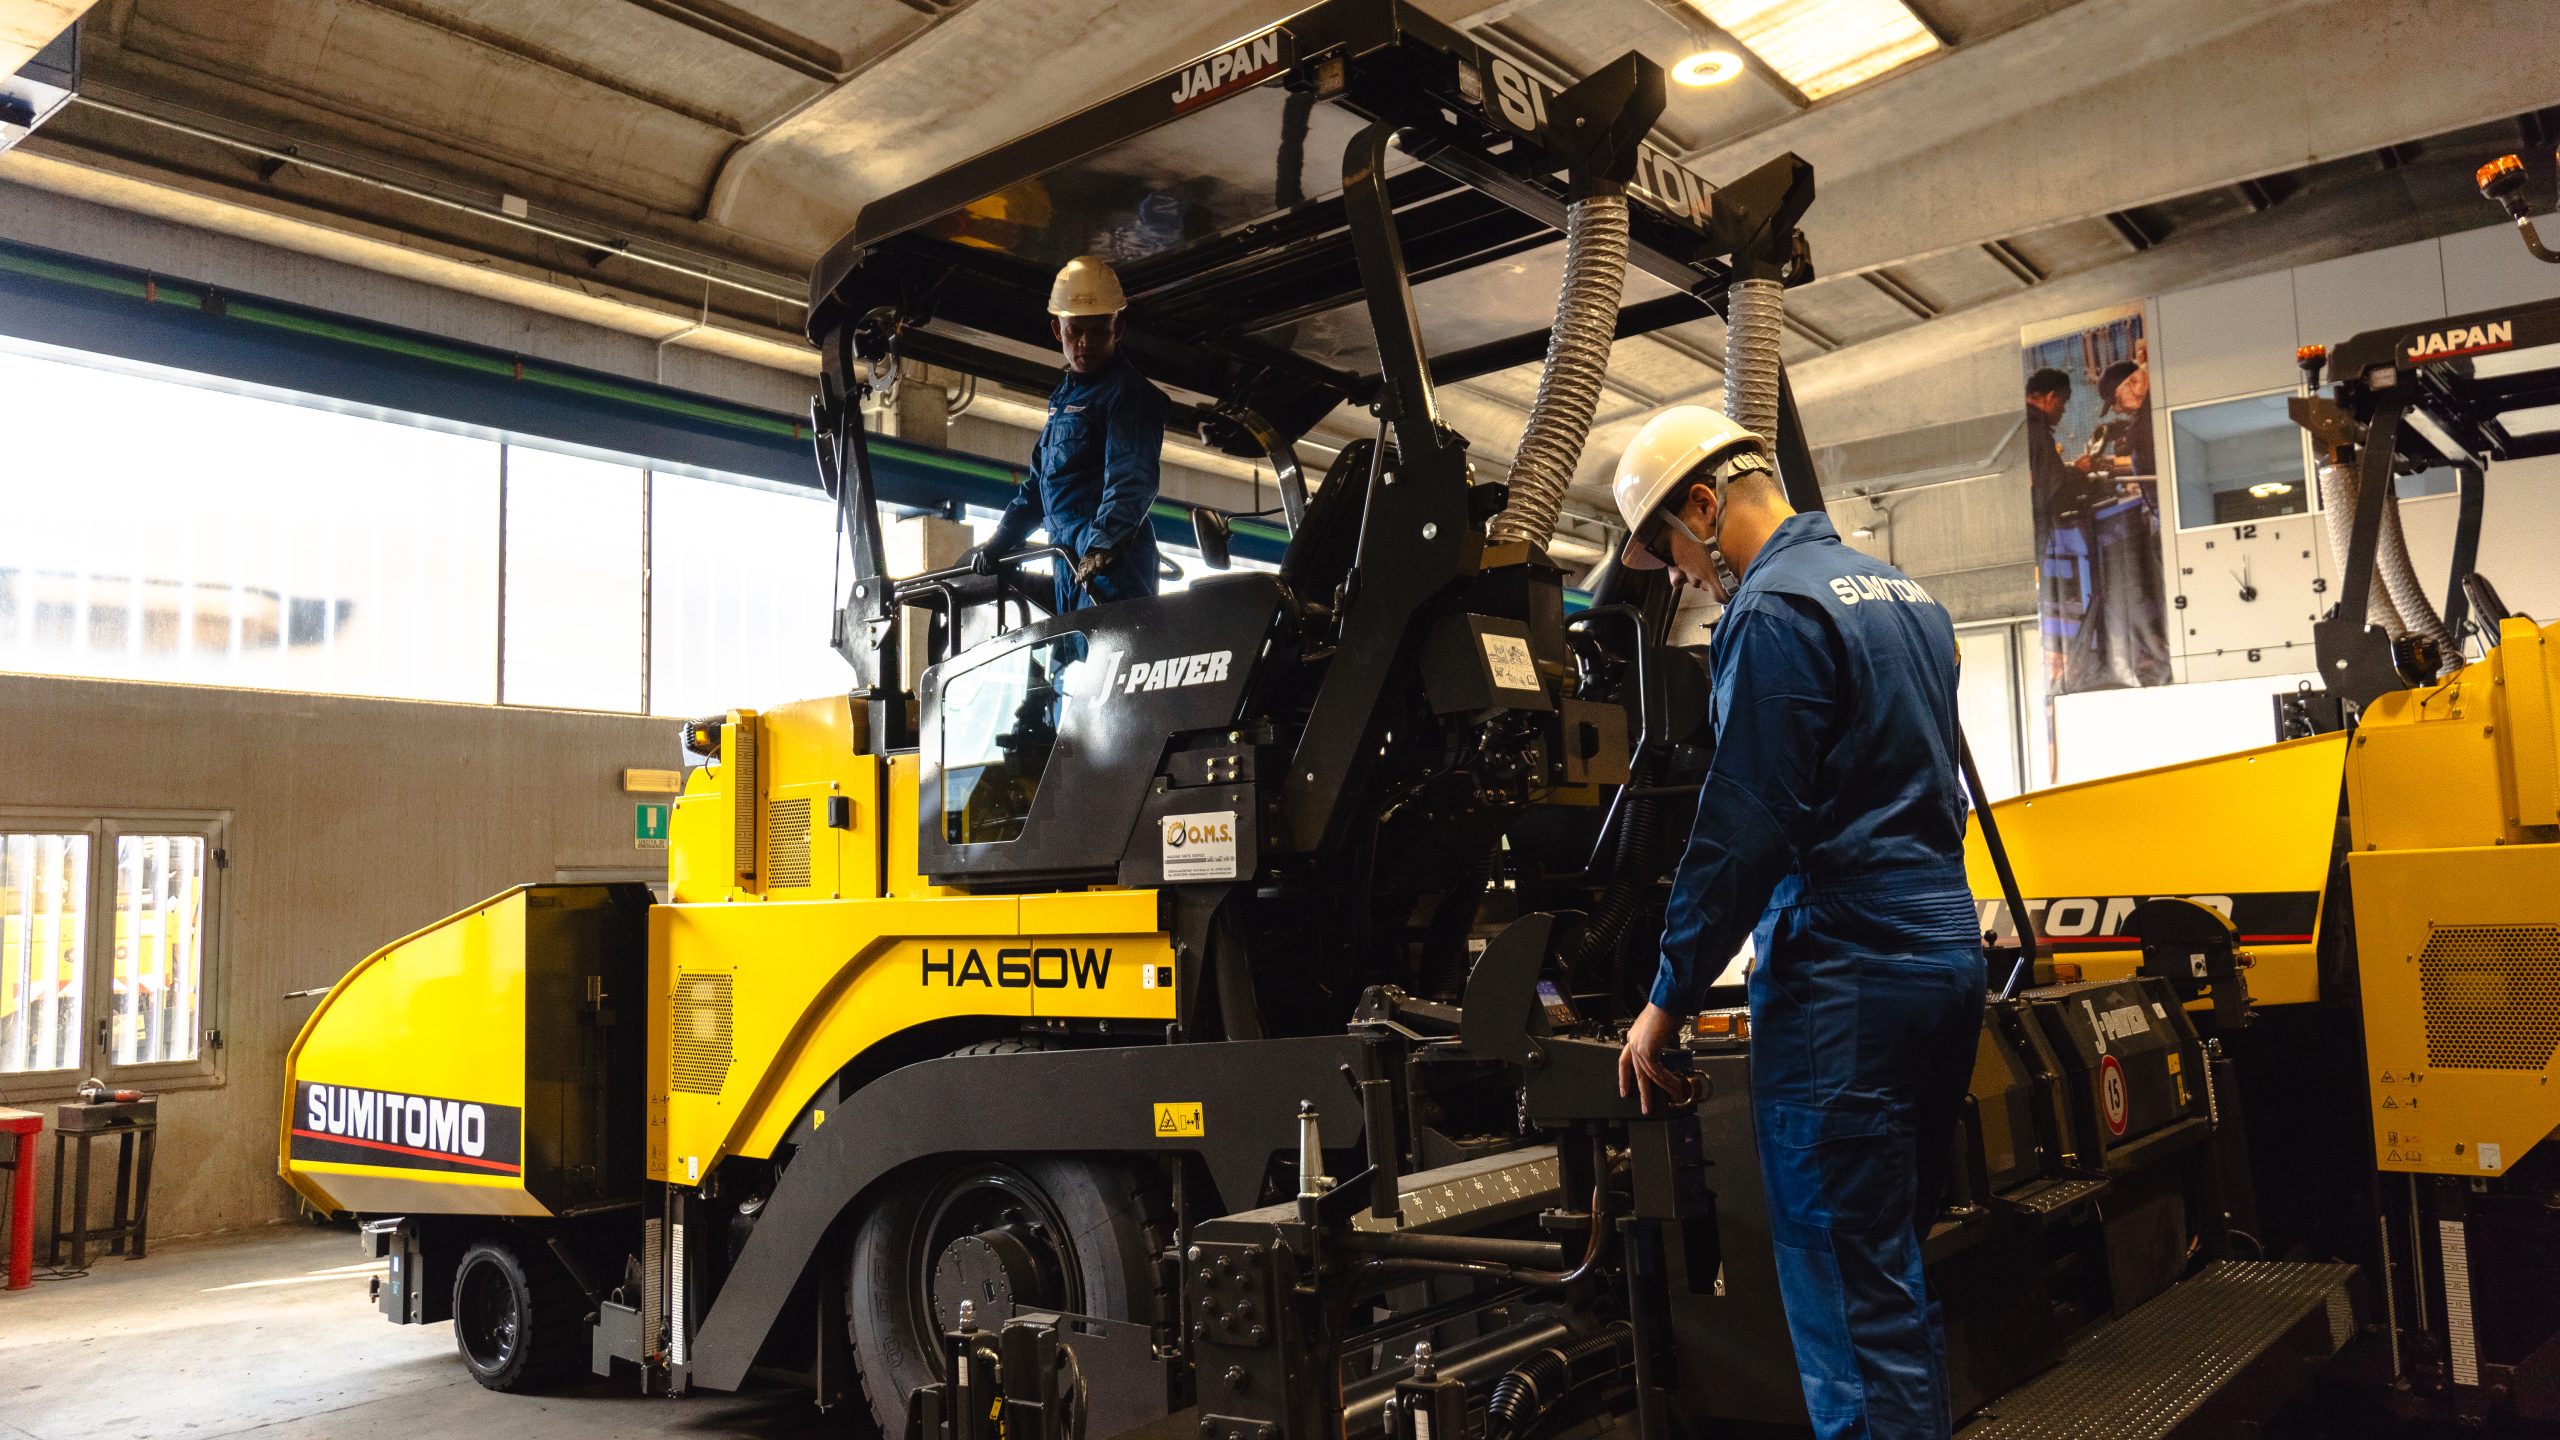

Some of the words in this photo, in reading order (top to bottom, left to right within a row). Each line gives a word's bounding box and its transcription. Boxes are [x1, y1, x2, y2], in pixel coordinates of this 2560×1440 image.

[1171, 32, 1278, 103] JAPAN
[2407, 320, 2512, 357] JAPAN
[2233, 524, 2257, 540] 12
[2275, 532, 2280, 540] 1
[2205, 541, 2214, 549] 11
[2182, 567, 2193, 575] 10
[2312, 578, 2327, 593] 3
[2174, 595, 2188, 609] 9
[2248, 648, 2261, 662] 6
[1088, 650, 1232, 708] J-PAVER
[1188, 824, 1232, 844] O.M.S.
[922, 948, 1112, 989] HA60W
[2108, 1079, 2120, 1110] 15
[308, 1084, 485, 1157] SUMITOMO
